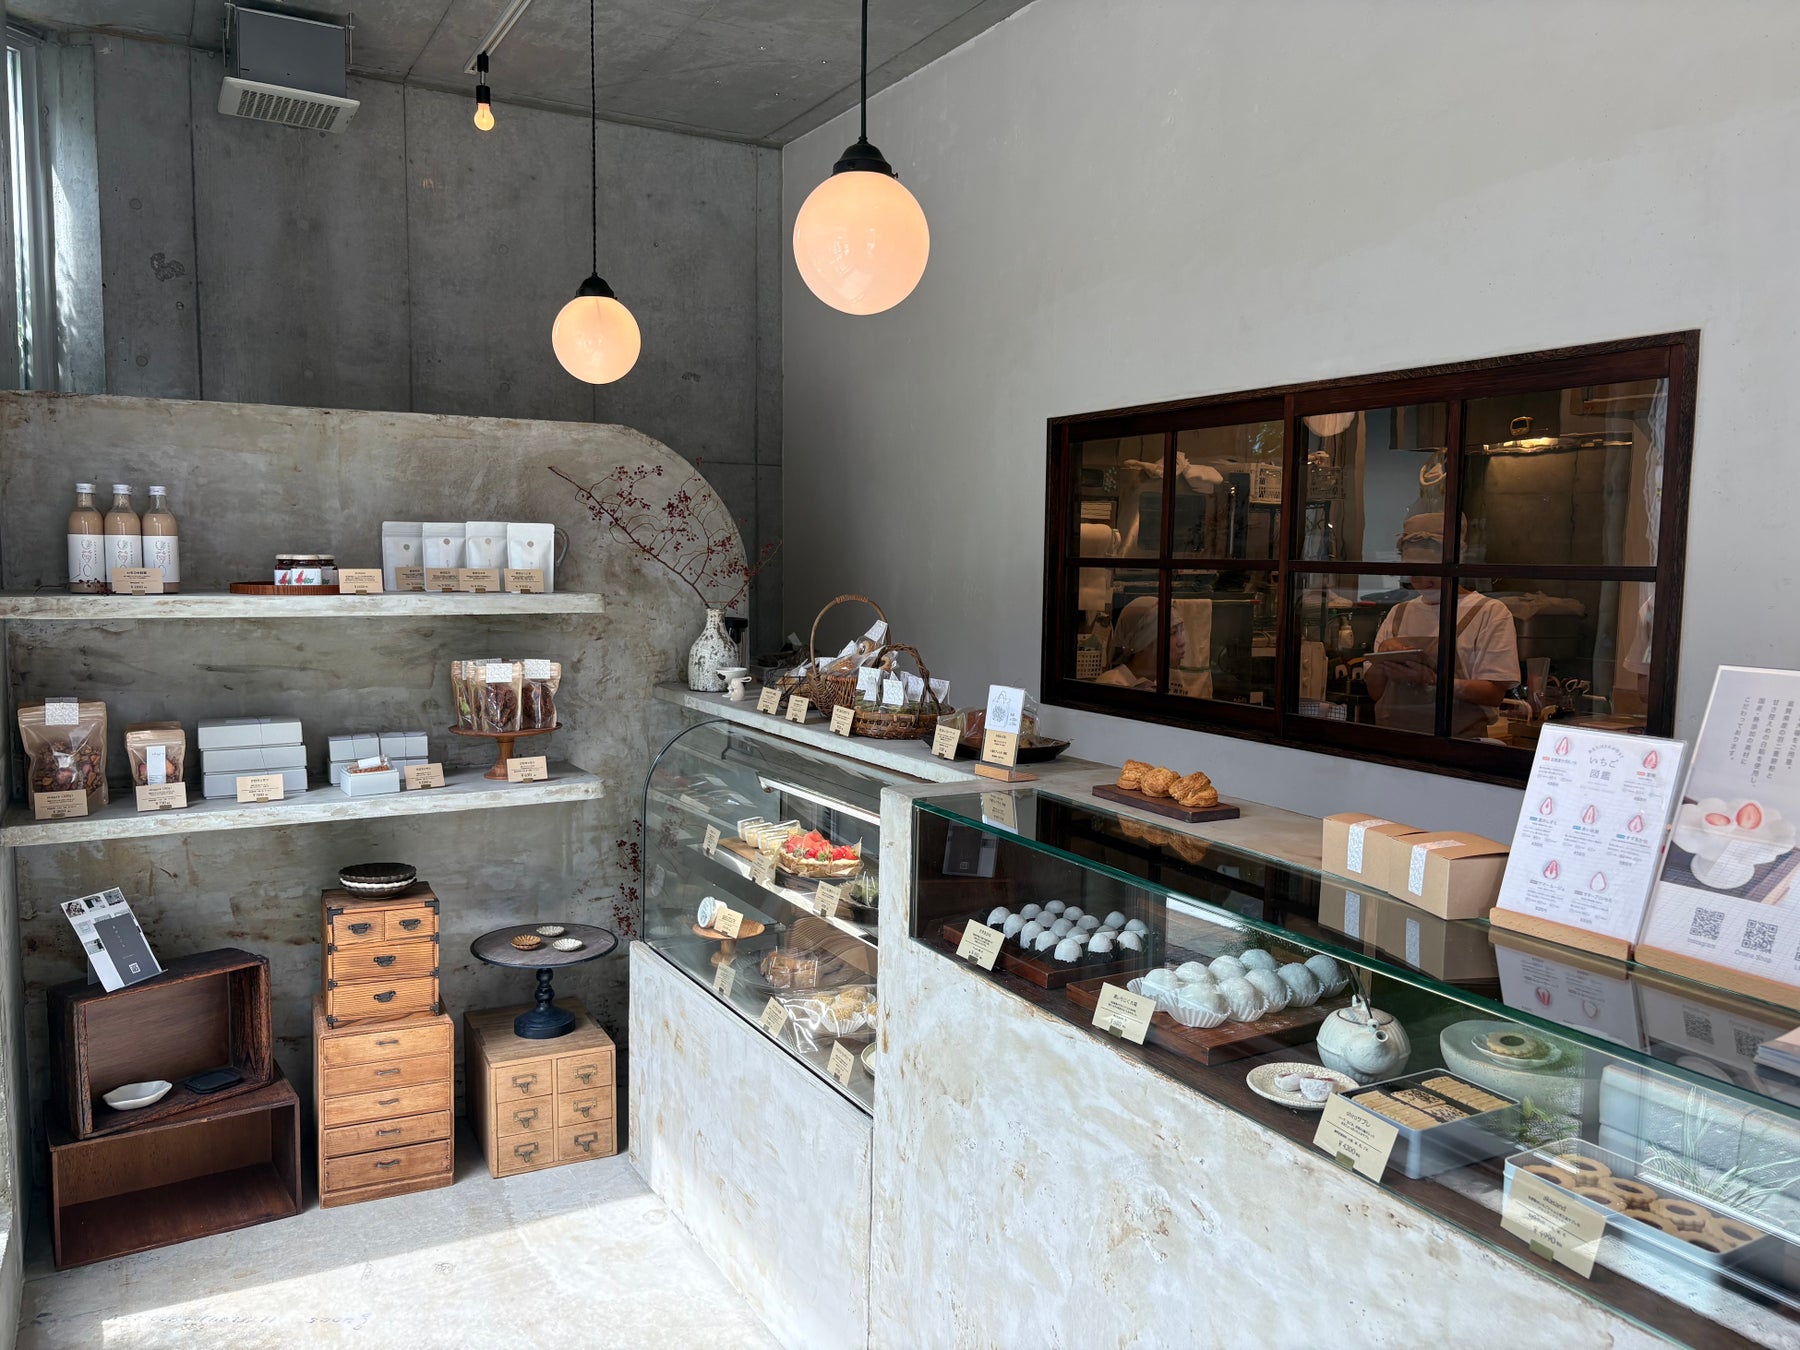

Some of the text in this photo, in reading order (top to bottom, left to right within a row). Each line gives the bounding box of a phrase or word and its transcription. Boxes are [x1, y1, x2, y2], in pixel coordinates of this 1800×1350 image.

[1589, 757, 1619, 768] いちご
[1589, 768, 1612, 781] 図鑑
[1734, 949, 1772, 964] Online Shop
